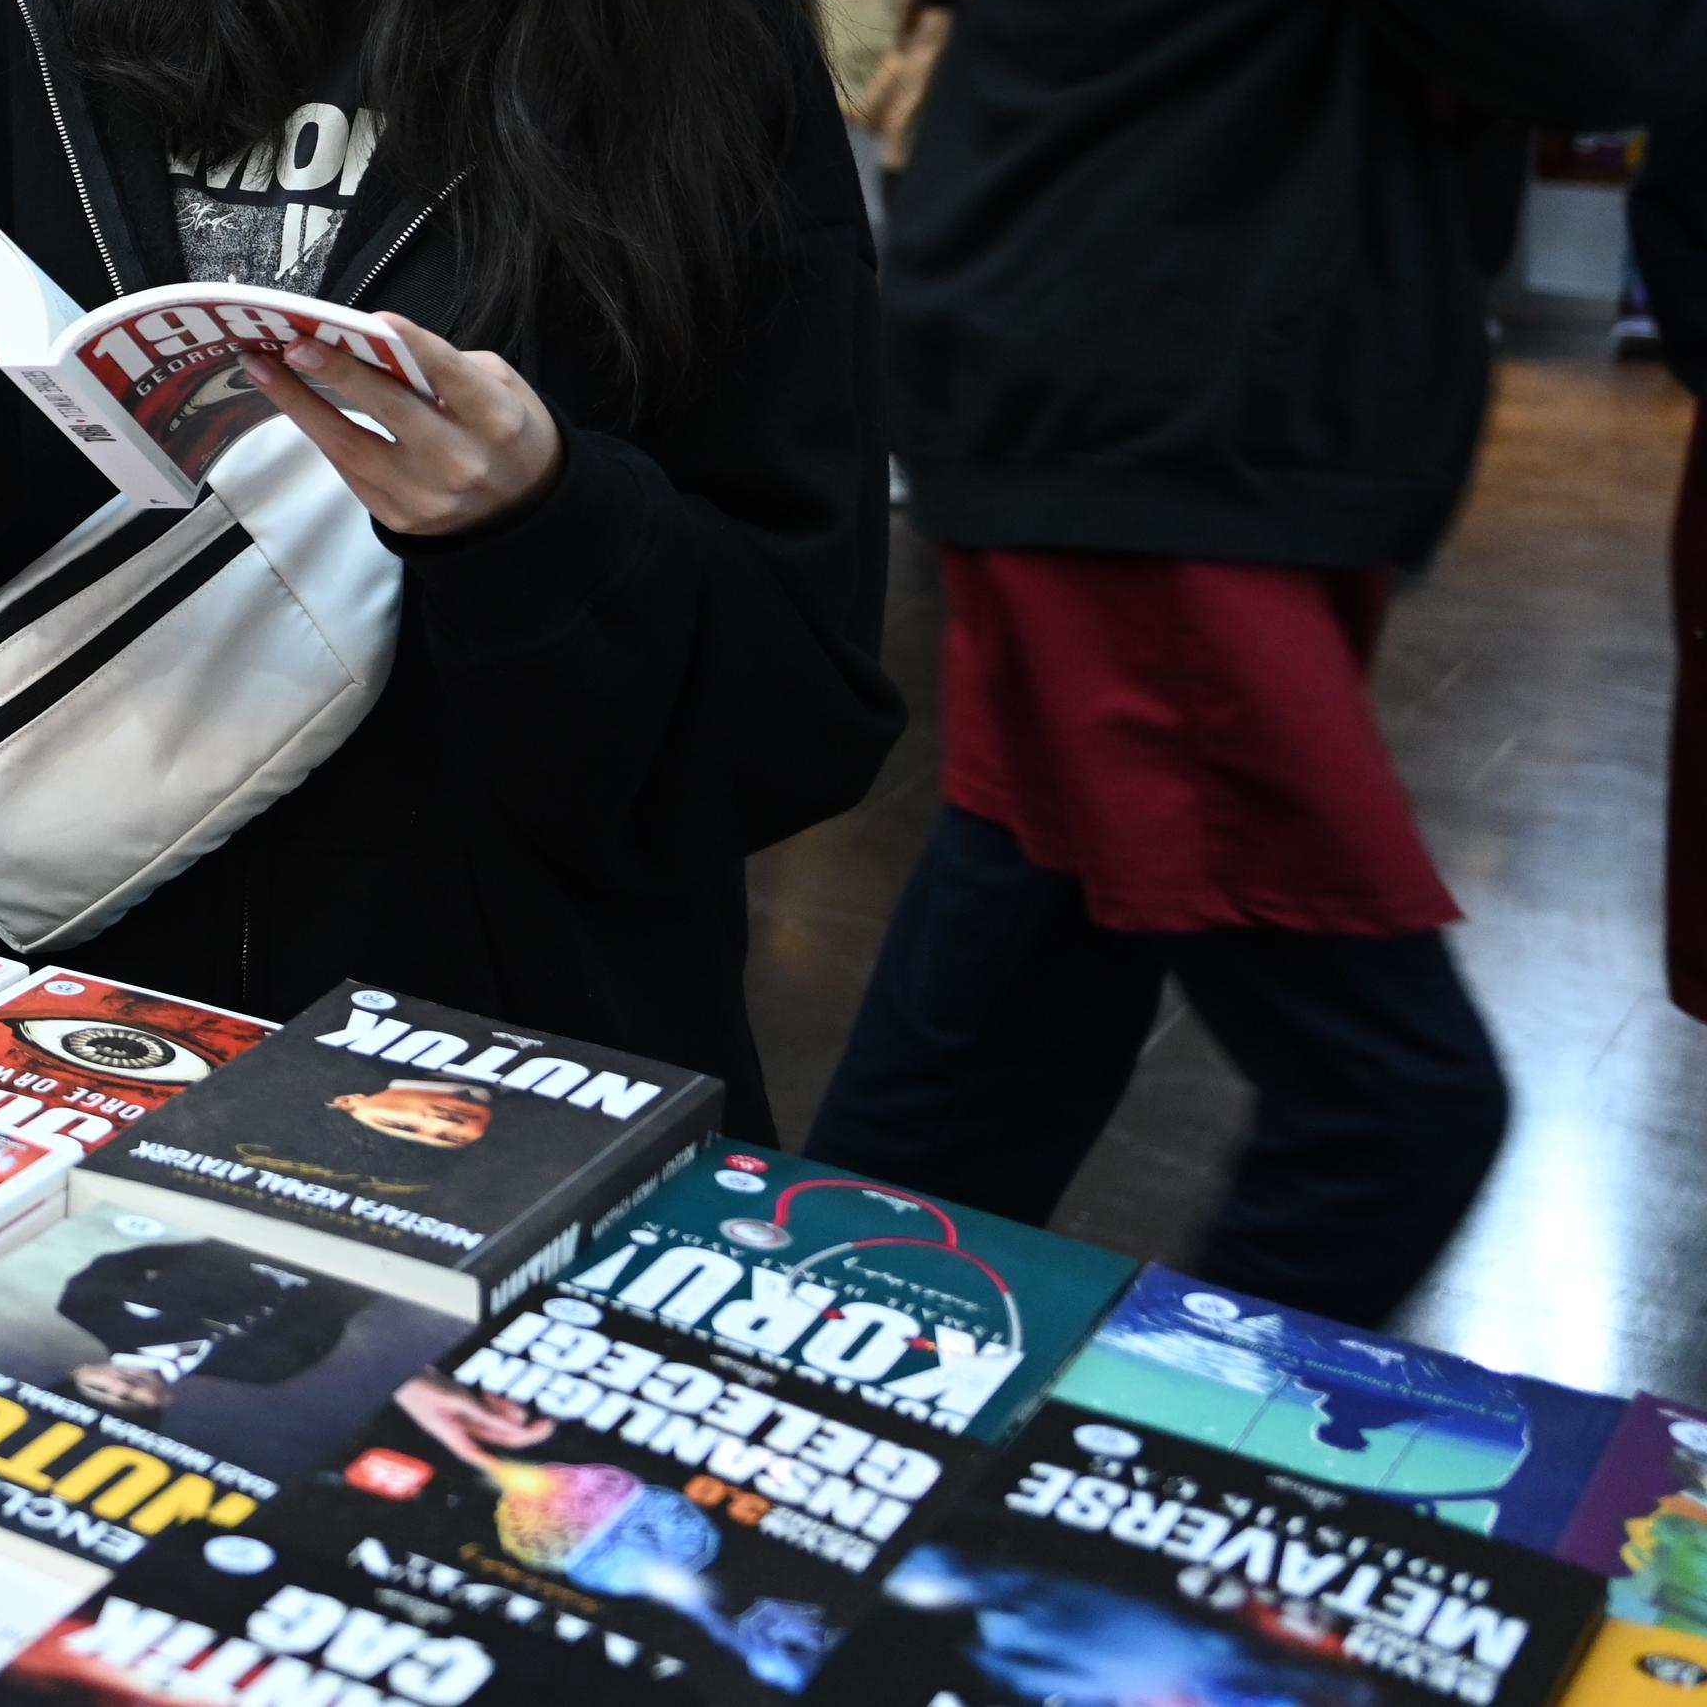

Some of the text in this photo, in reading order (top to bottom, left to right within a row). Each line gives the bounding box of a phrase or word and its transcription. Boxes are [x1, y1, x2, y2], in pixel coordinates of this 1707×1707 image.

[136, 339, 243, 398] GEORGE
[313, 1007, 664, 1122] NUTUK
[70, 1086, 146, 1121] ORGE
[252, 1164, 348, 1210] KEMAL
[351, 1190, 486, 1252] MUSTAFA
[570, 1228, 1025, 1419] KORU!
[1003, 1460, 1529, 1671] METAVERSE
